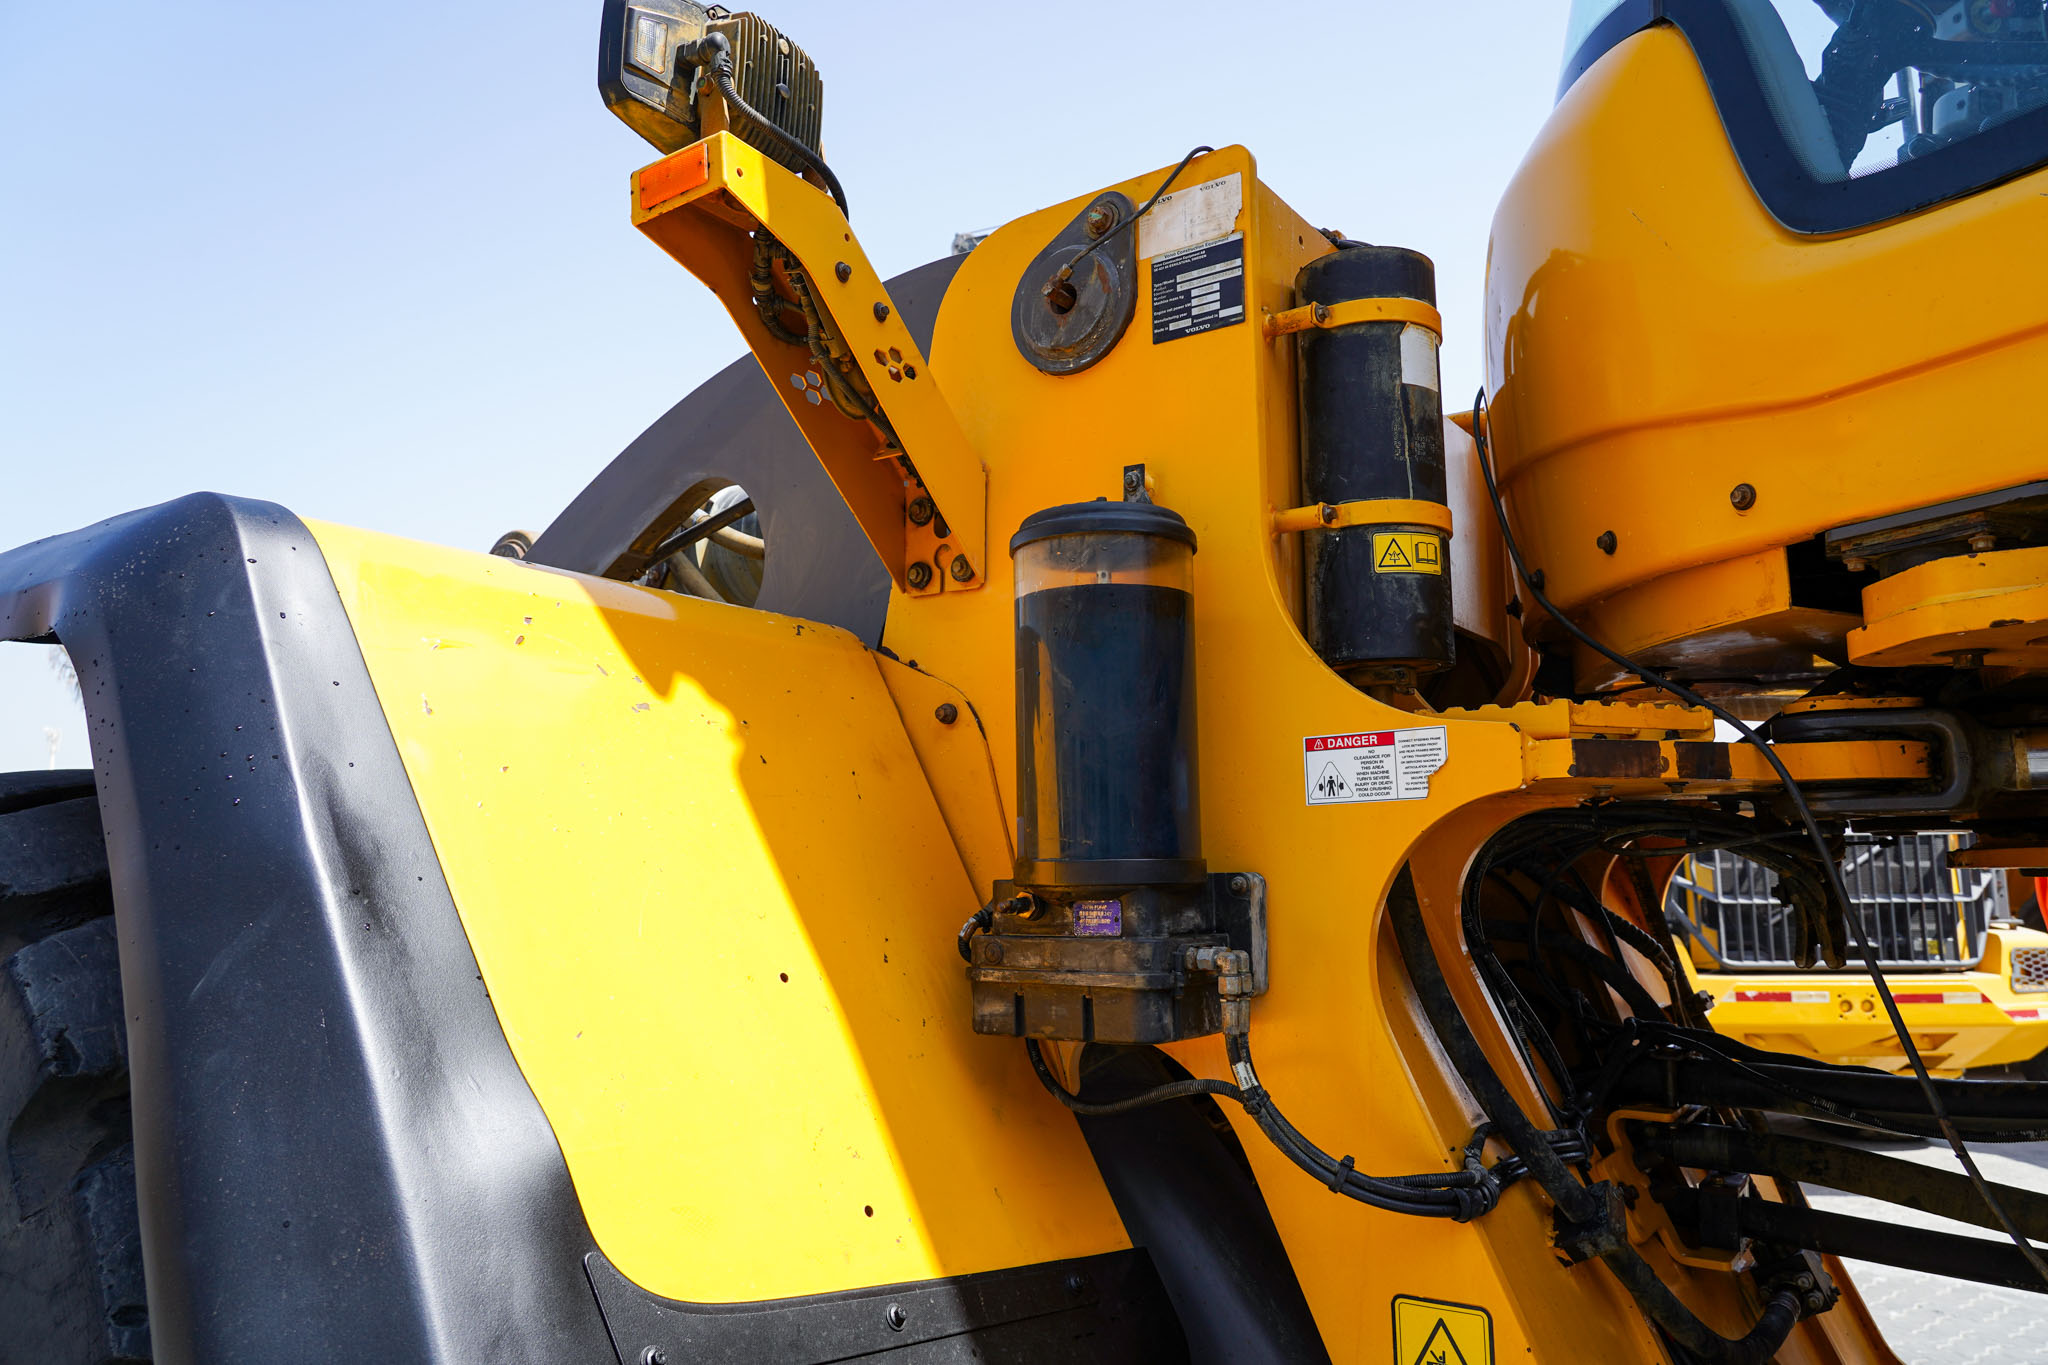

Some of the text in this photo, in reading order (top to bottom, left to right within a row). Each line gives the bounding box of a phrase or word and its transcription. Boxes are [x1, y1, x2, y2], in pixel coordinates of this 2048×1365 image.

[1199, 180, 1226, 192] VOLVO
[1177, 244, 1204, 256] Construction
[1204, 237, 1229, 248] Equipment
[1163, 257, 1182, 266] Construction
[1183, 252, 1200, 261] Equipment
[1185, 323, 1210, 334] VOLVO
[1327, 735, 1378, 748] DANGER
